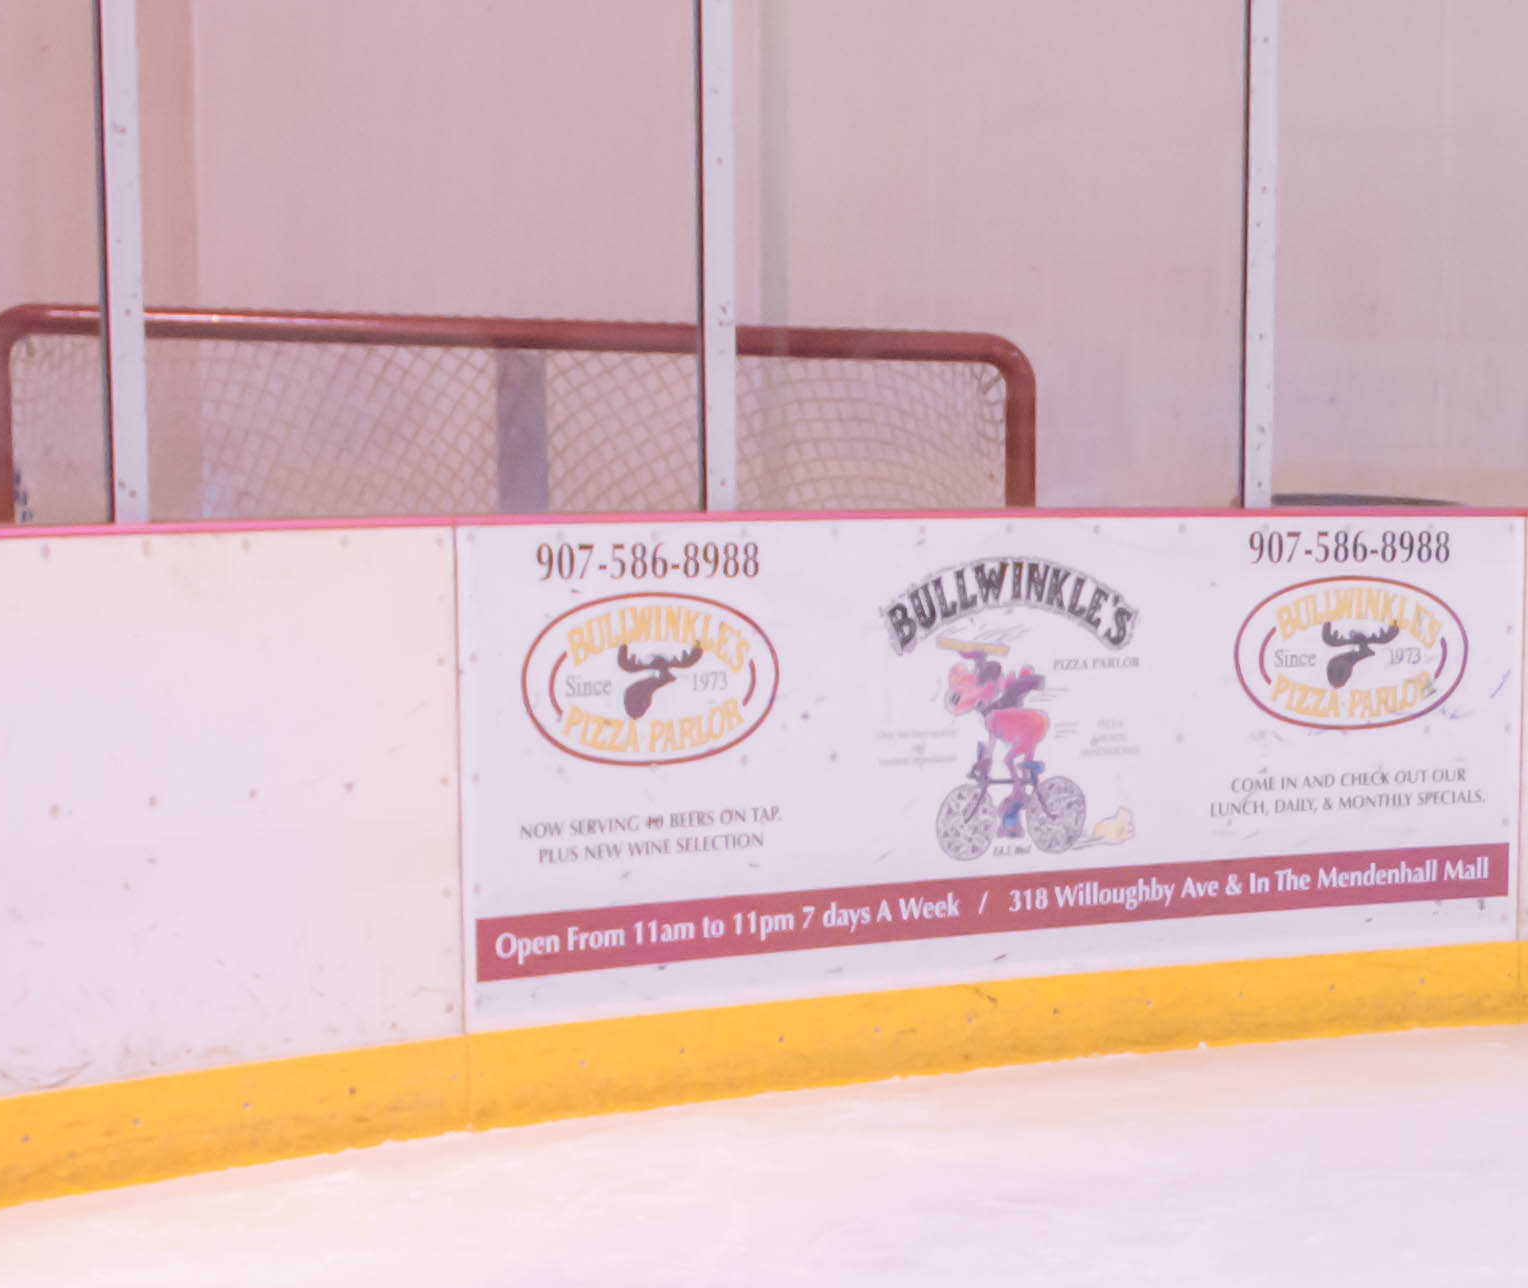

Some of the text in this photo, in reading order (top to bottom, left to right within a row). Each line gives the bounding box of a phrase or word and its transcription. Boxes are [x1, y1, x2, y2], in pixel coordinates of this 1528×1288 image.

[536, 542, 760, 581] 907-586-8988
[1249, 530, 1450, 564] 907-586-8988
[886, 560, 1132, 650] BULLWINKLE'S
[1274, 648, 1317, 668] Since
[1389, 647, 1422, 665] 1973
[565, 675, 613, 697] Since
[692, 671, 728, 692] 1973
[1272, 669, 1437, 718] PIZZA PARLOR
[562, 697, 745, 752] PIZZA PARLOR
[1230, 767, 1467, 793] COME IN AND CHECK OUT OUR
[1322, 796, 1333, 811] &
[1339, 792, 1413, 810] MONTHLY
[520, 822, 564, 840] NOW
[569, 815, 639, 837] SERVING
[671, 809, 715, 829] BEERS
[719, 807, 746, 826] ON
[538, 832, 764, 865] PLUS NEW WINE SELECTION
[495, 855, 1490, 965] Open From 11am to 11pm 7 days A Week / 318 Willoughby Ave & In The Mendenhall Mall
